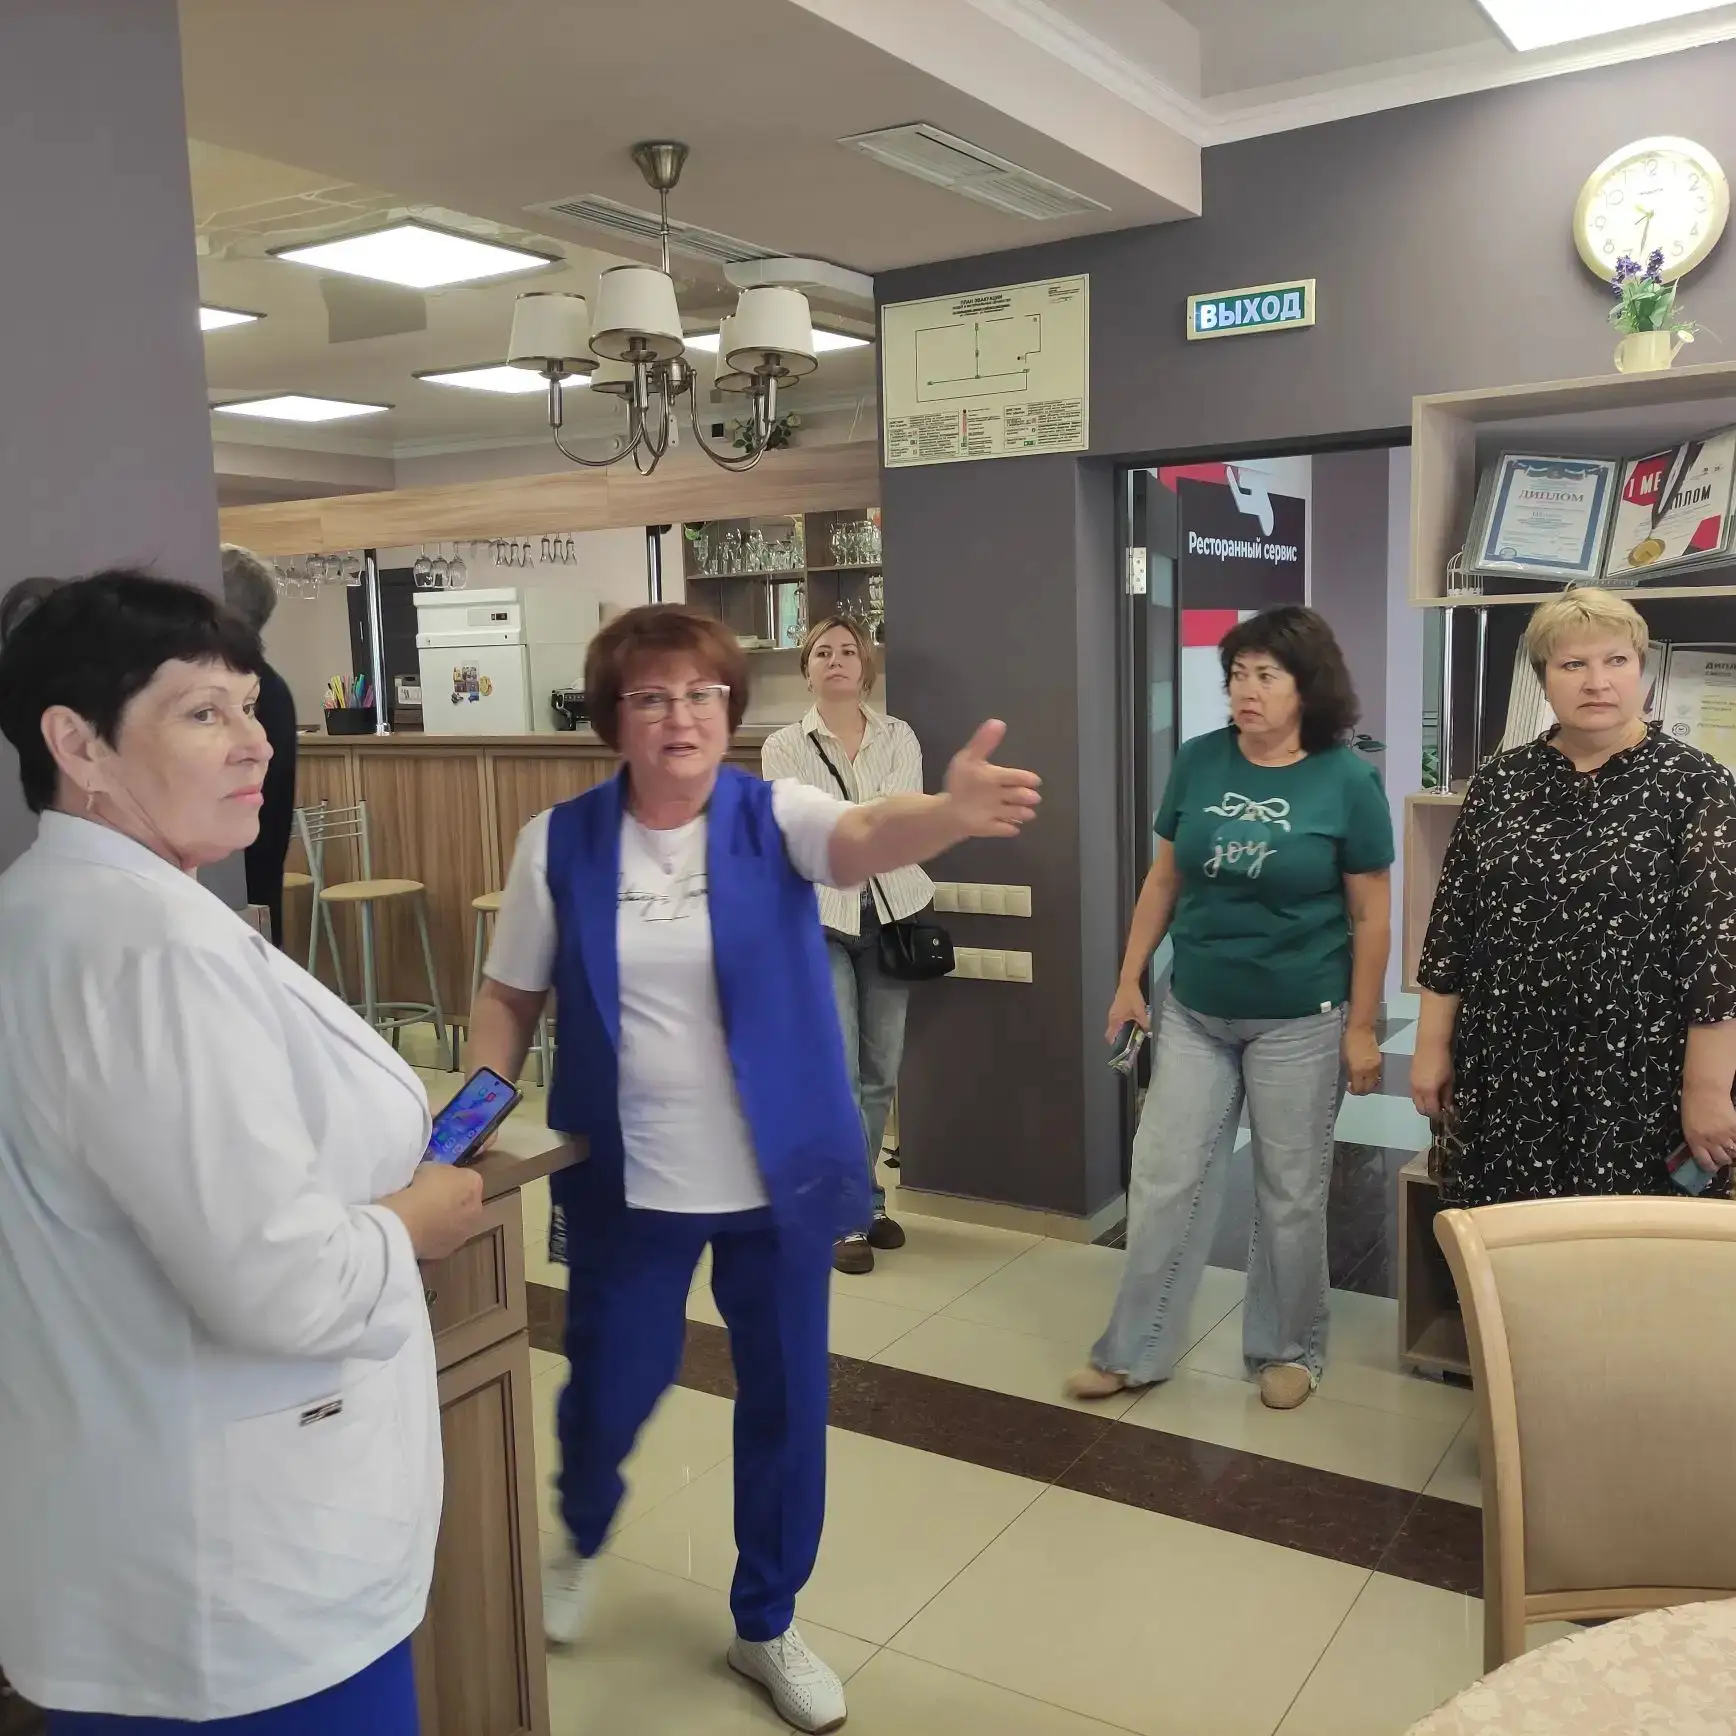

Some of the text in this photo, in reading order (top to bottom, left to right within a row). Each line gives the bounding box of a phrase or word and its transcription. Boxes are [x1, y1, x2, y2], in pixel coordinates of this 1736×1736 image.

[1200, 291, 1302, 329] ВЫХОД
[1518, 489, 1585, 503] ДИПЛОМ
[1671, 484, 1712, 510] ПЛОМ
[1188, 530, 1298, 566] Ресторанный сервис
[1203, 836, 1278, 880] joy
